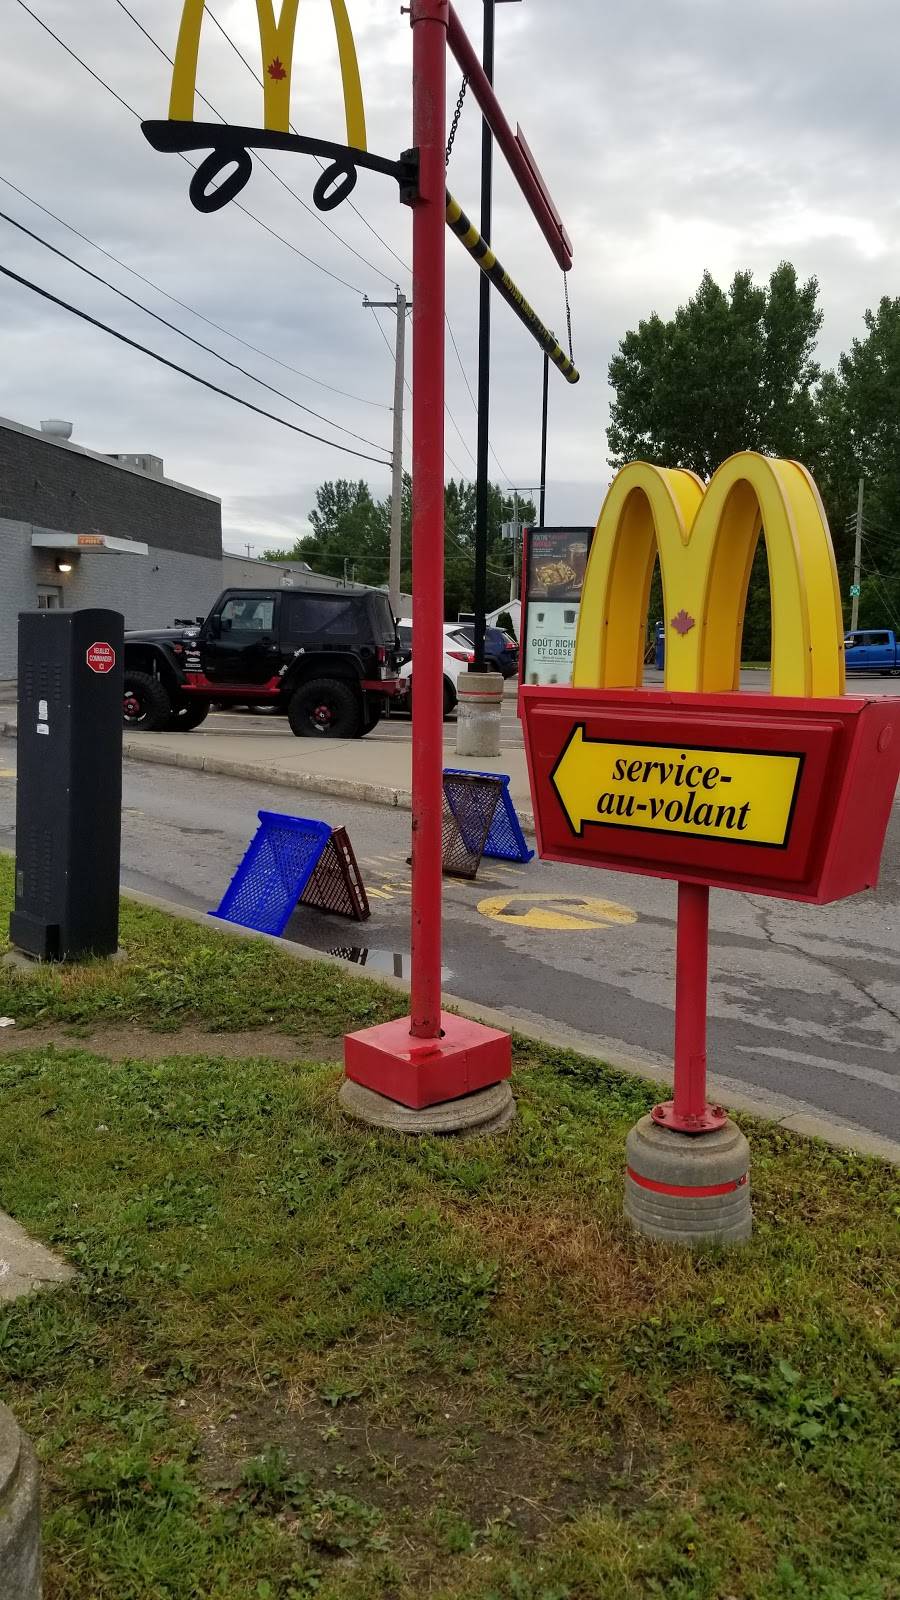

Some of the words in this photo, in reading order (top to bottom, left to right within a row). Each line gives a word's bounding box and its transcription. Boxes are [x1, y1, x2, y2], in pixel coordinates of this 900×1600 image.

[532, 638, 552, 647] GOÛT
[612, 753, 732, 790] service-
[596, 791, 751, 831] au-volant
